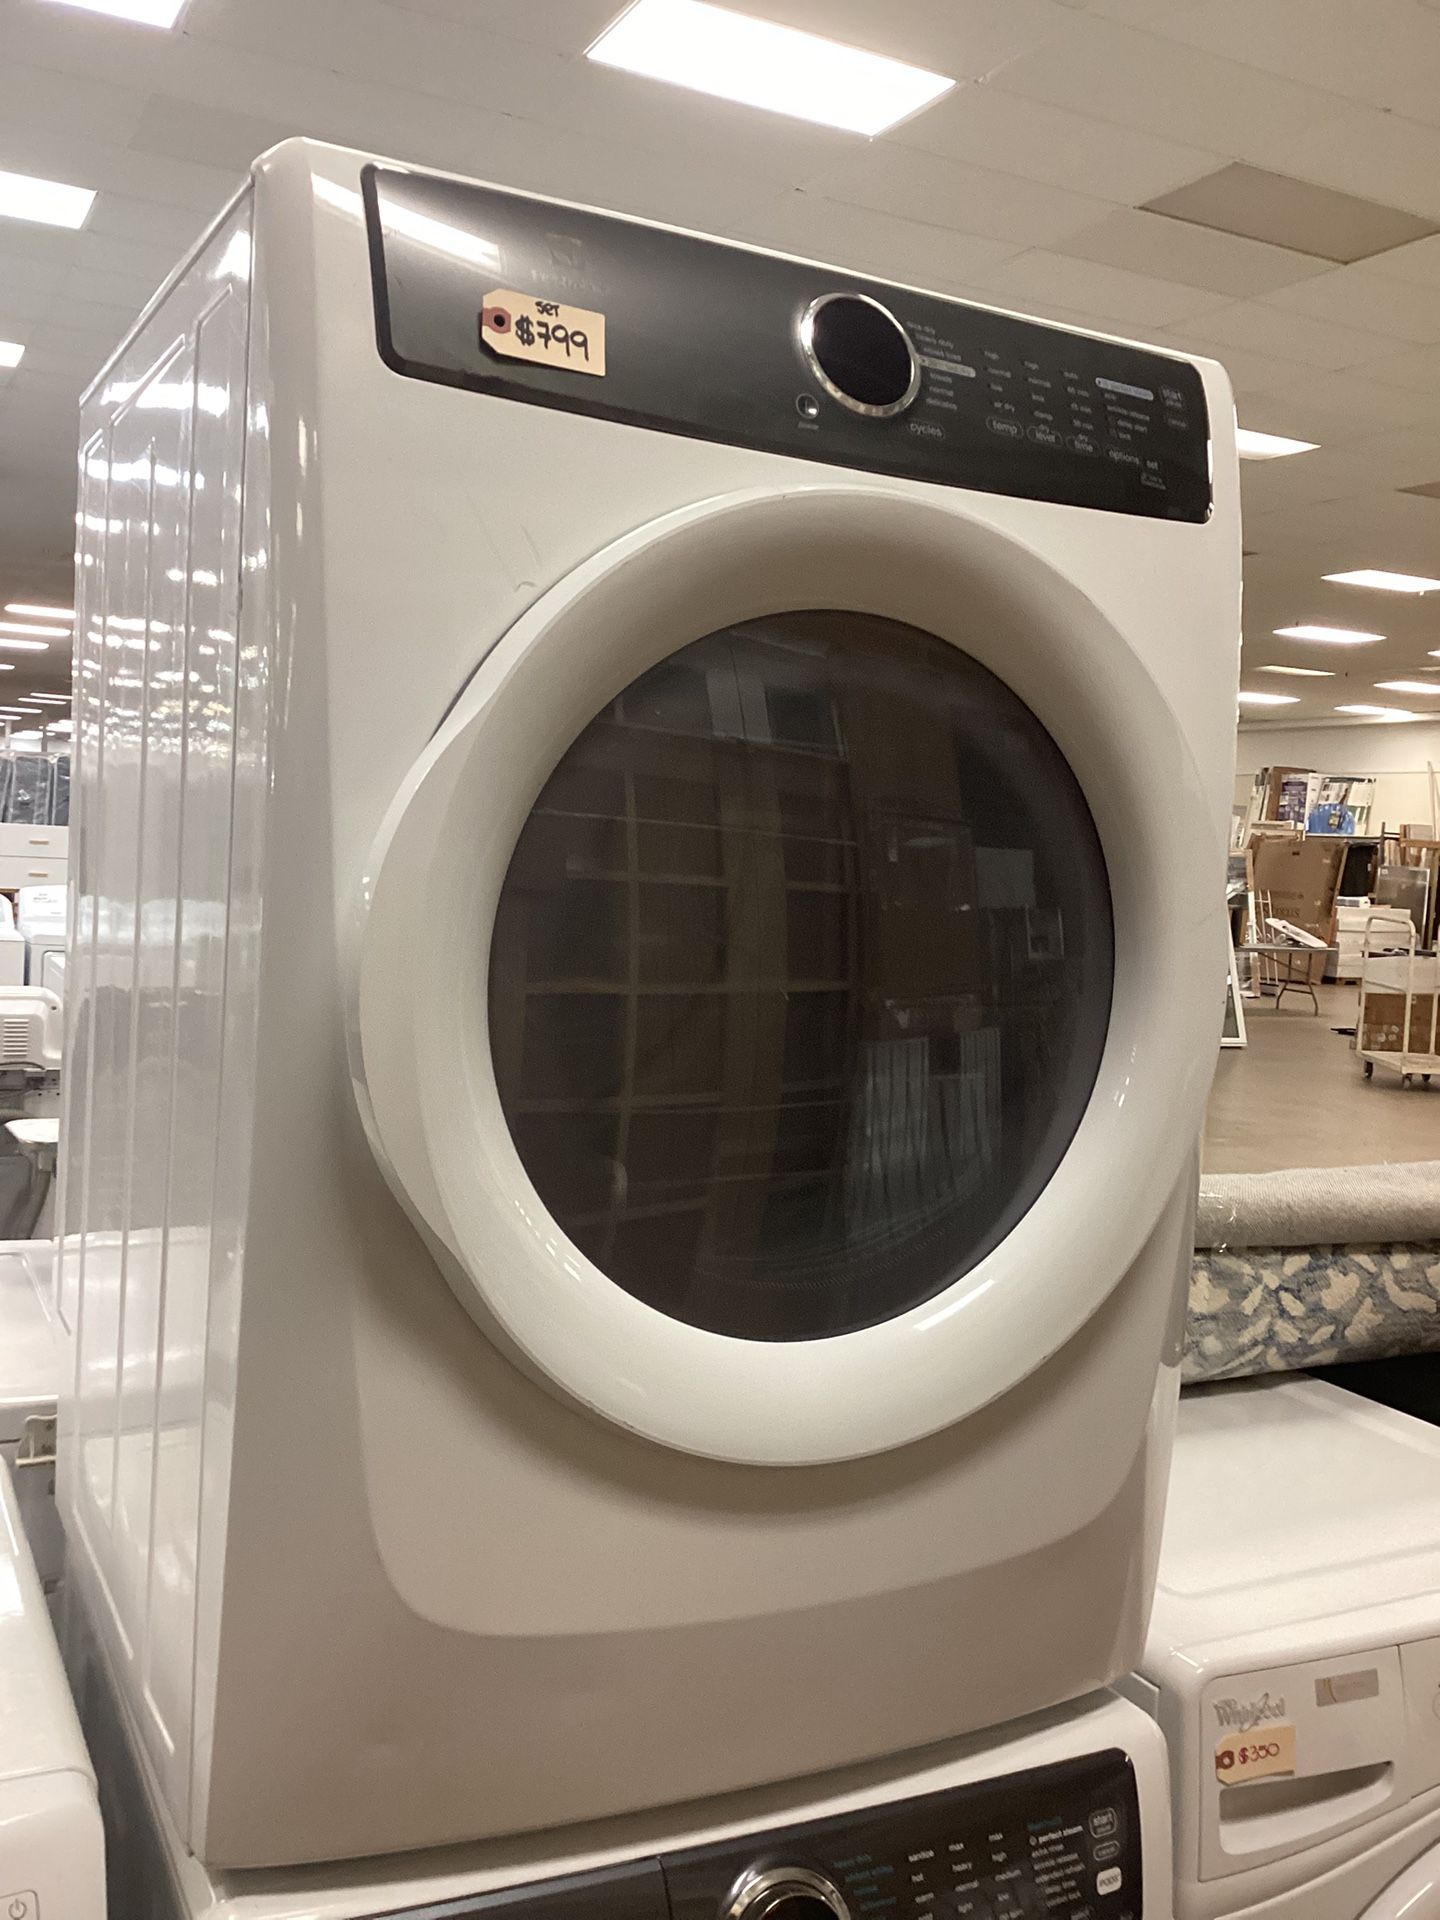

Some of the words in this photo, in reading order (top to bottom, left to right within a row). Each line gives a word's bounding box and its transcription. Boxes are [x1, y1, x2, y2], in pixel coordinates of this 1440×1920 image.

[515, 314, 590, 362] $799
[909, 422, 944, 438] cycles
[992, 419, 1019, 437] temp
[1238, 1742, 1281, 1765] $350
